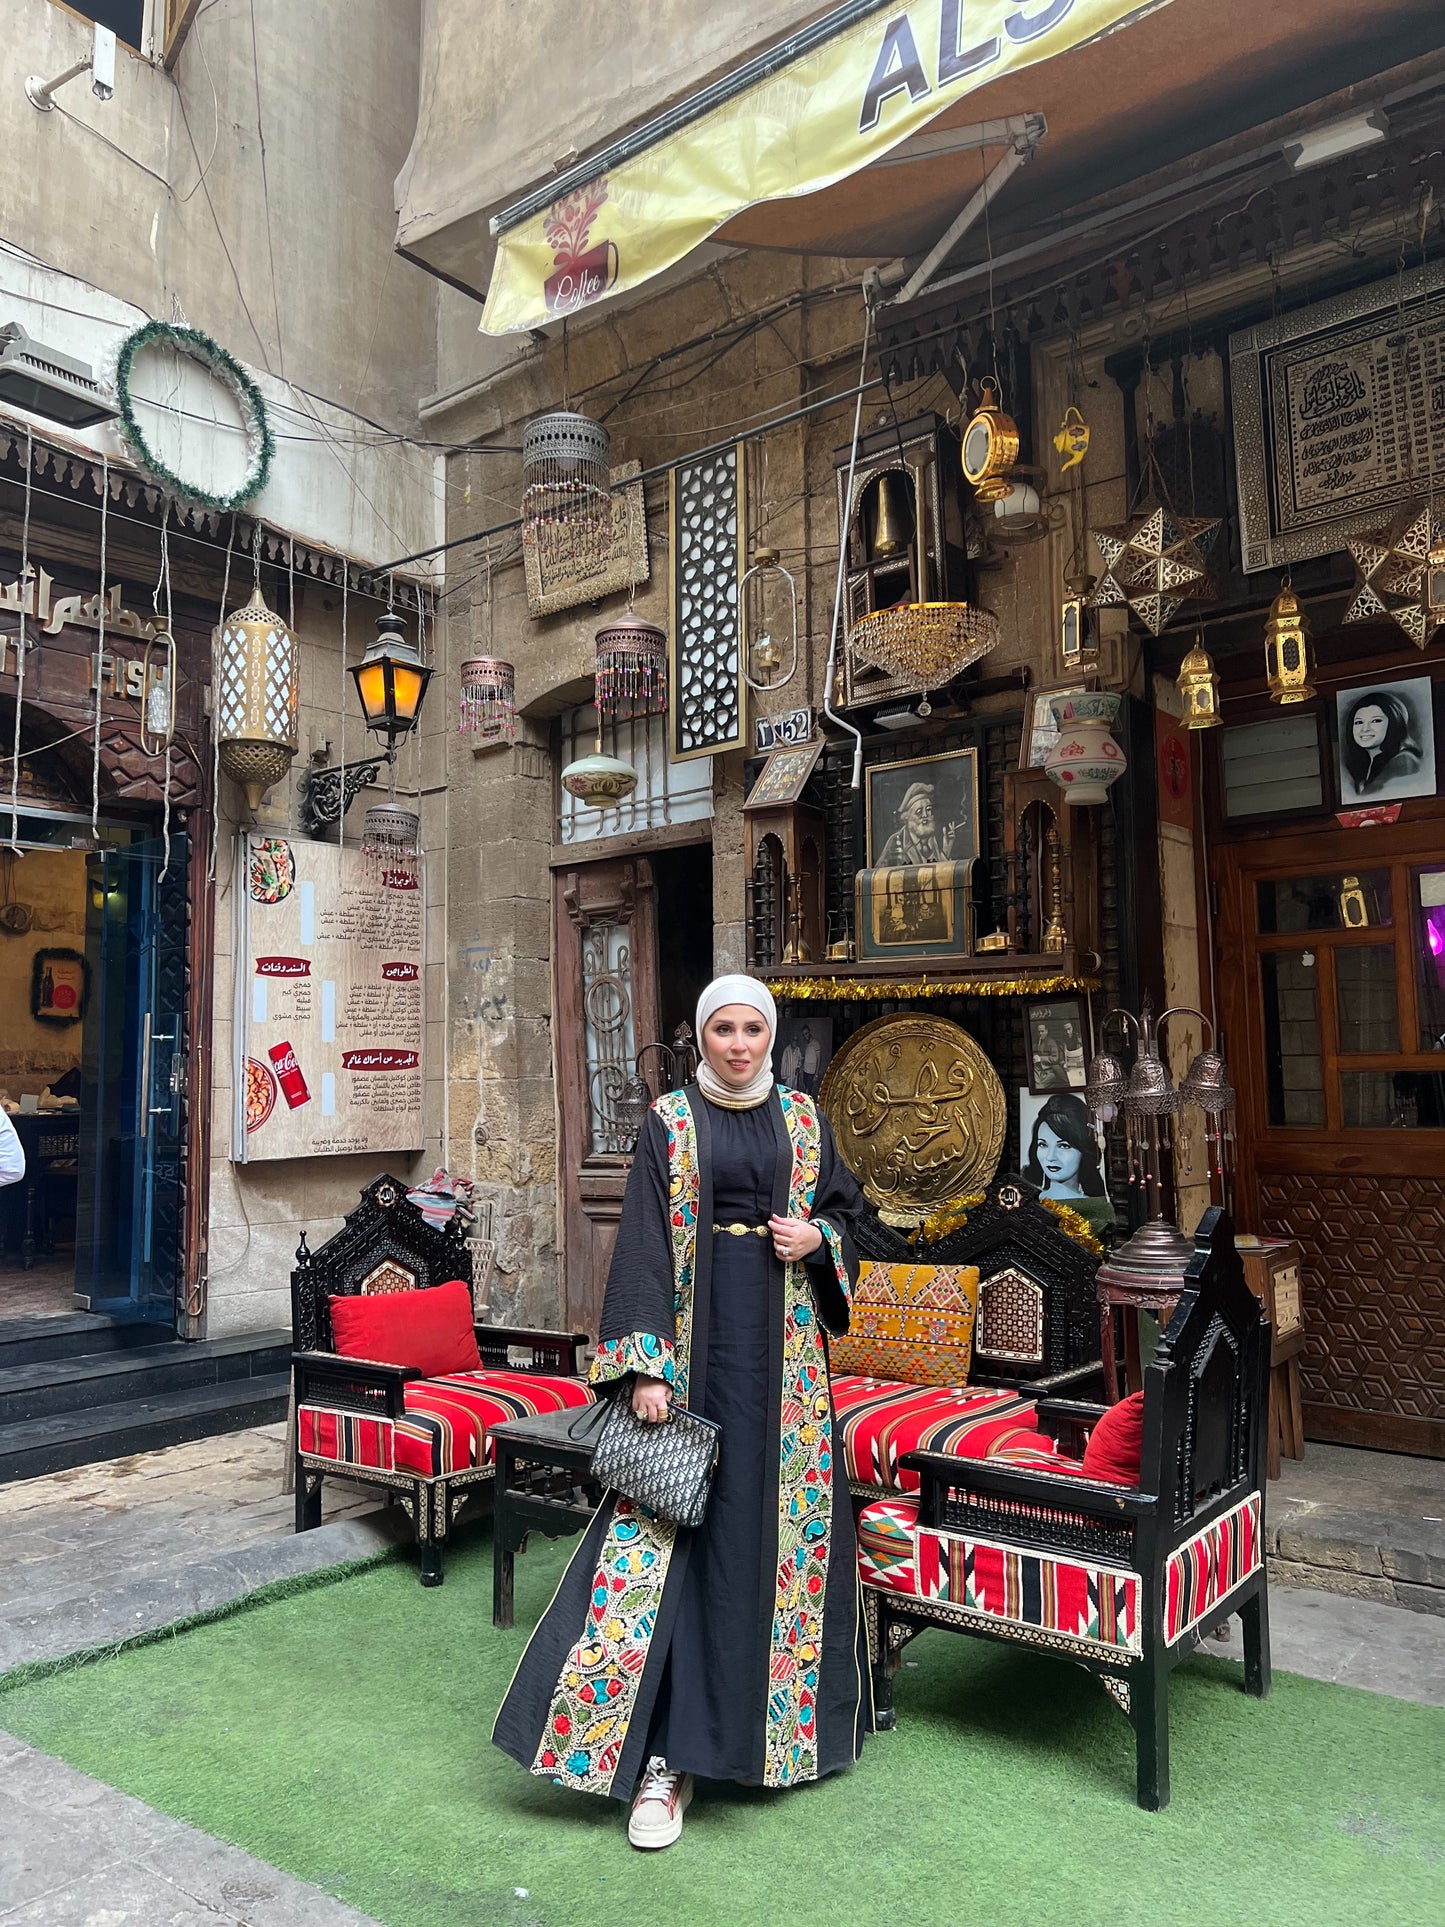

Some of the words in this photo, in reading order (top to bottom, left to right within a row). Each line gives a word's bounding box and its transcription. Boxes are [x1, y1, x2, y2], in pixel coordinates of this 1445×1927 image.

[554, 269, 600, 310] Coffee
[92, 652, 171, 698] FISH
[785, 713, 807, 740] 32
[386, 964, 414, 977] الطواجن
[363, 1052, 382, 1065] أسماك
